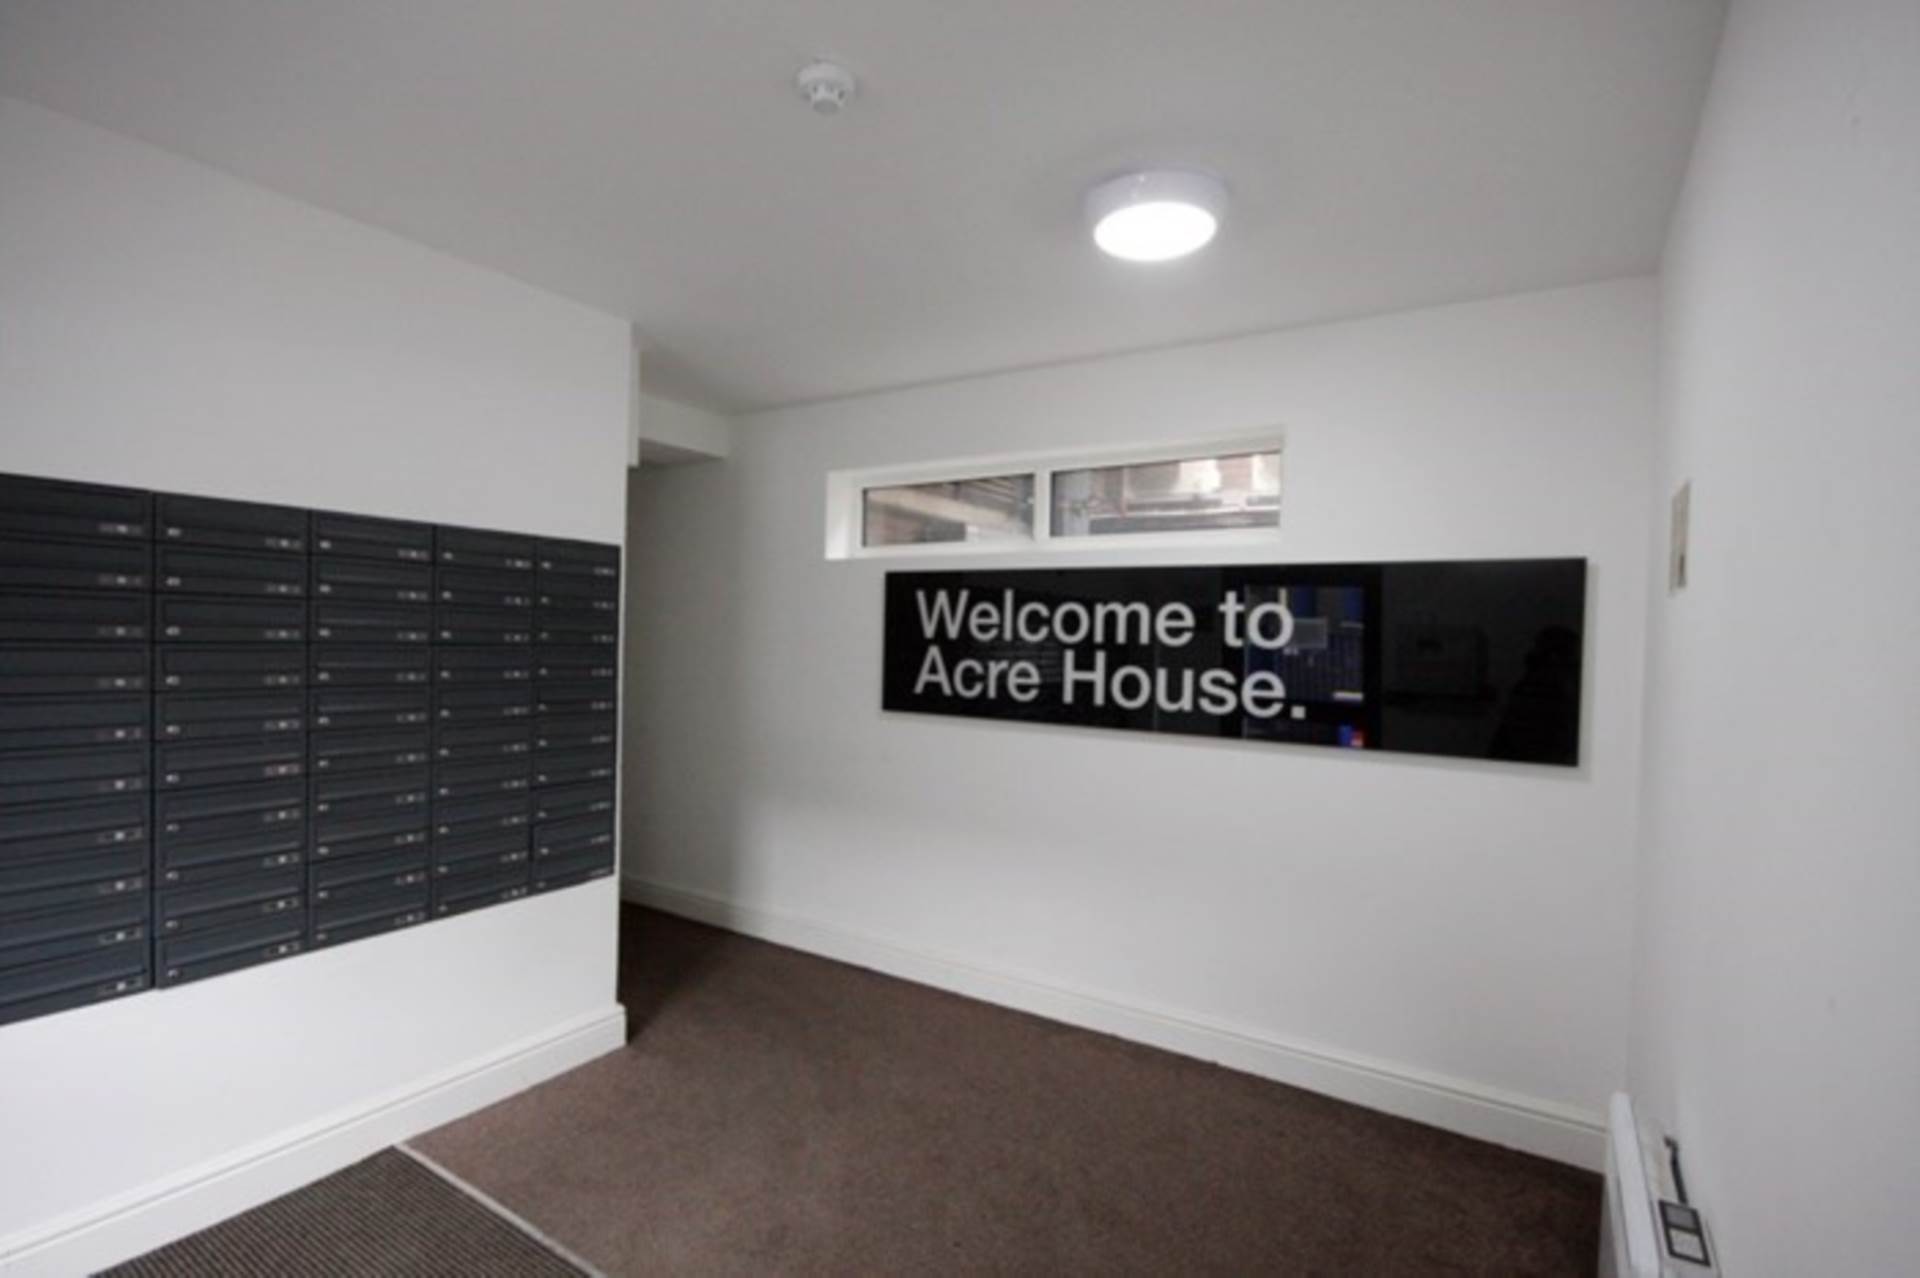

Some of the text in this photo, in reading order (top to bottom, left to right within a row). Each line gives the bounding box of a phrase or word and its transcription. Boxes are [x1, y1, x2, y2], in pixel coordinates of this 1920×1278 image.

[917, 590, 1294, 649] Welcome to
[915, 647, 1305, 718] Acre House.
